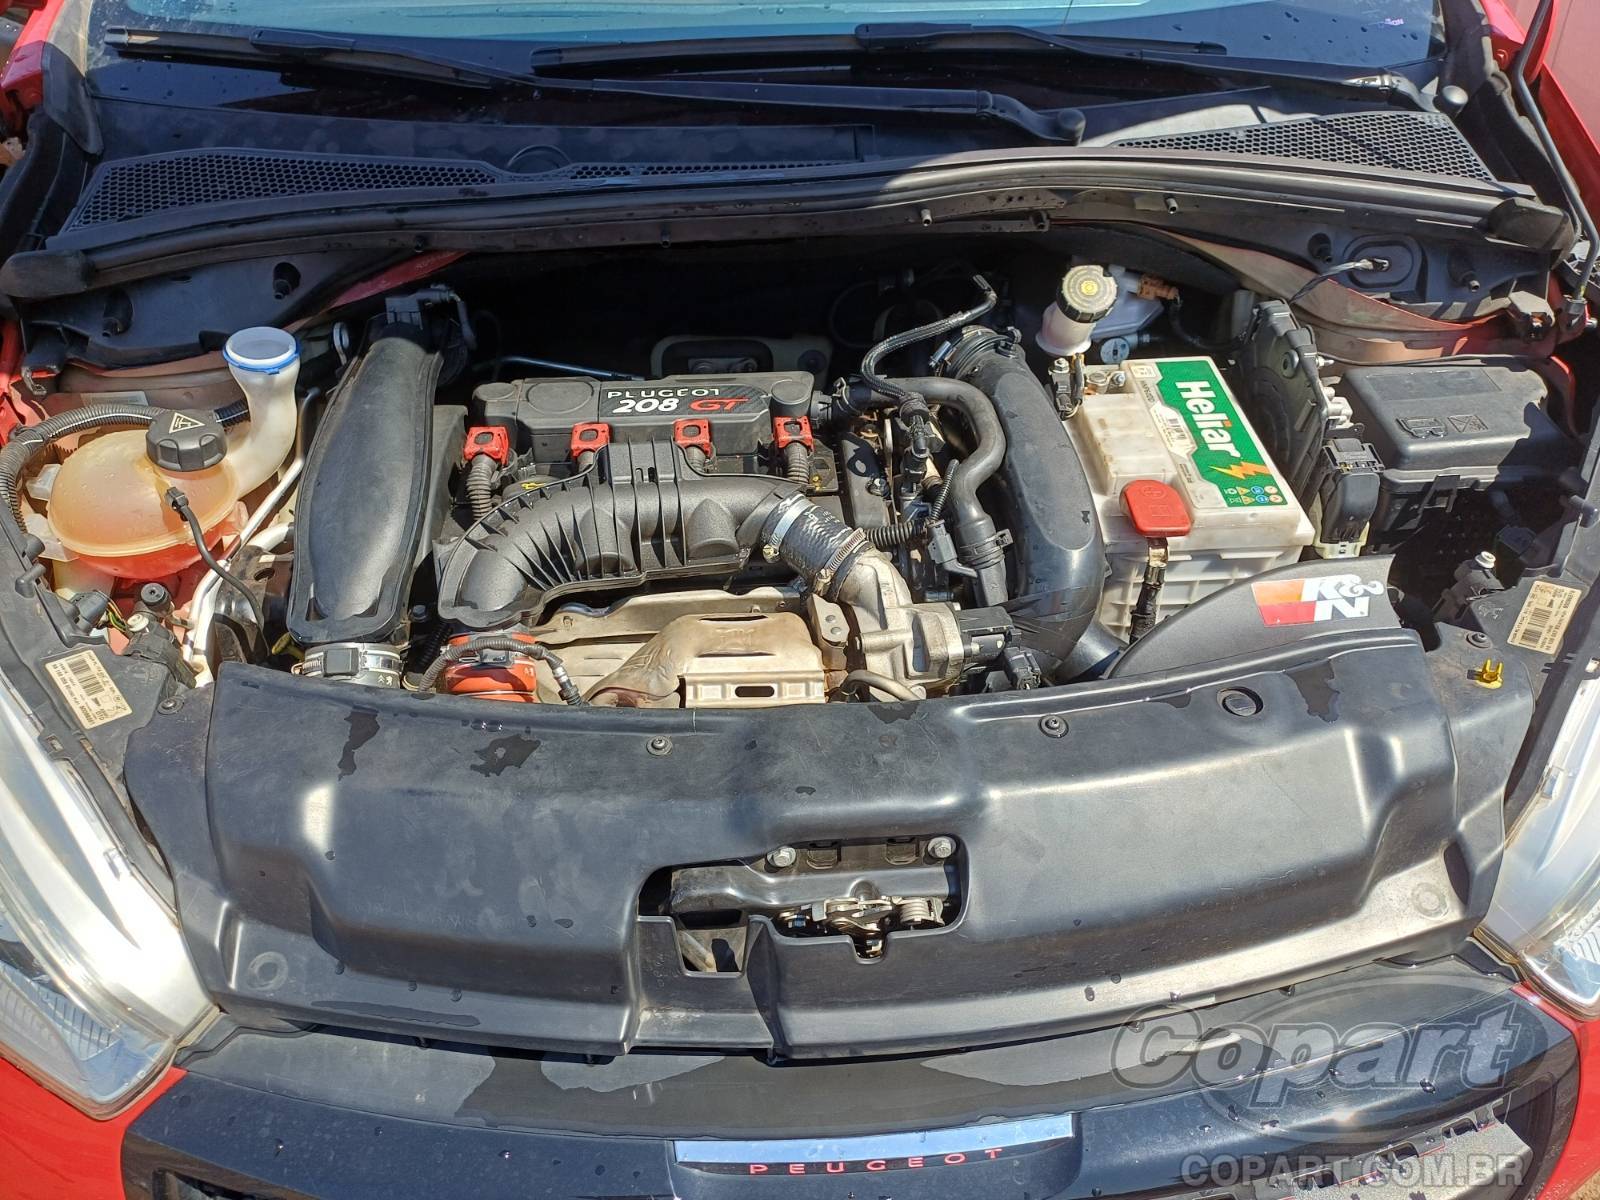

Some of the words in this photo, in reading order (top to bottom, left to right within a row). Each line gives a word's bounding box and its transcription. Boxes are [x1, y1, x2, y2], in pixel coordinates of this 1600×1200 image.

[612, 398, 680, 413] 208
[688, 396, 750, 412] GT
[1175, 380, 1241, 458] Heliar
[748, 1147, 1003, 1176] PEUGEOT
